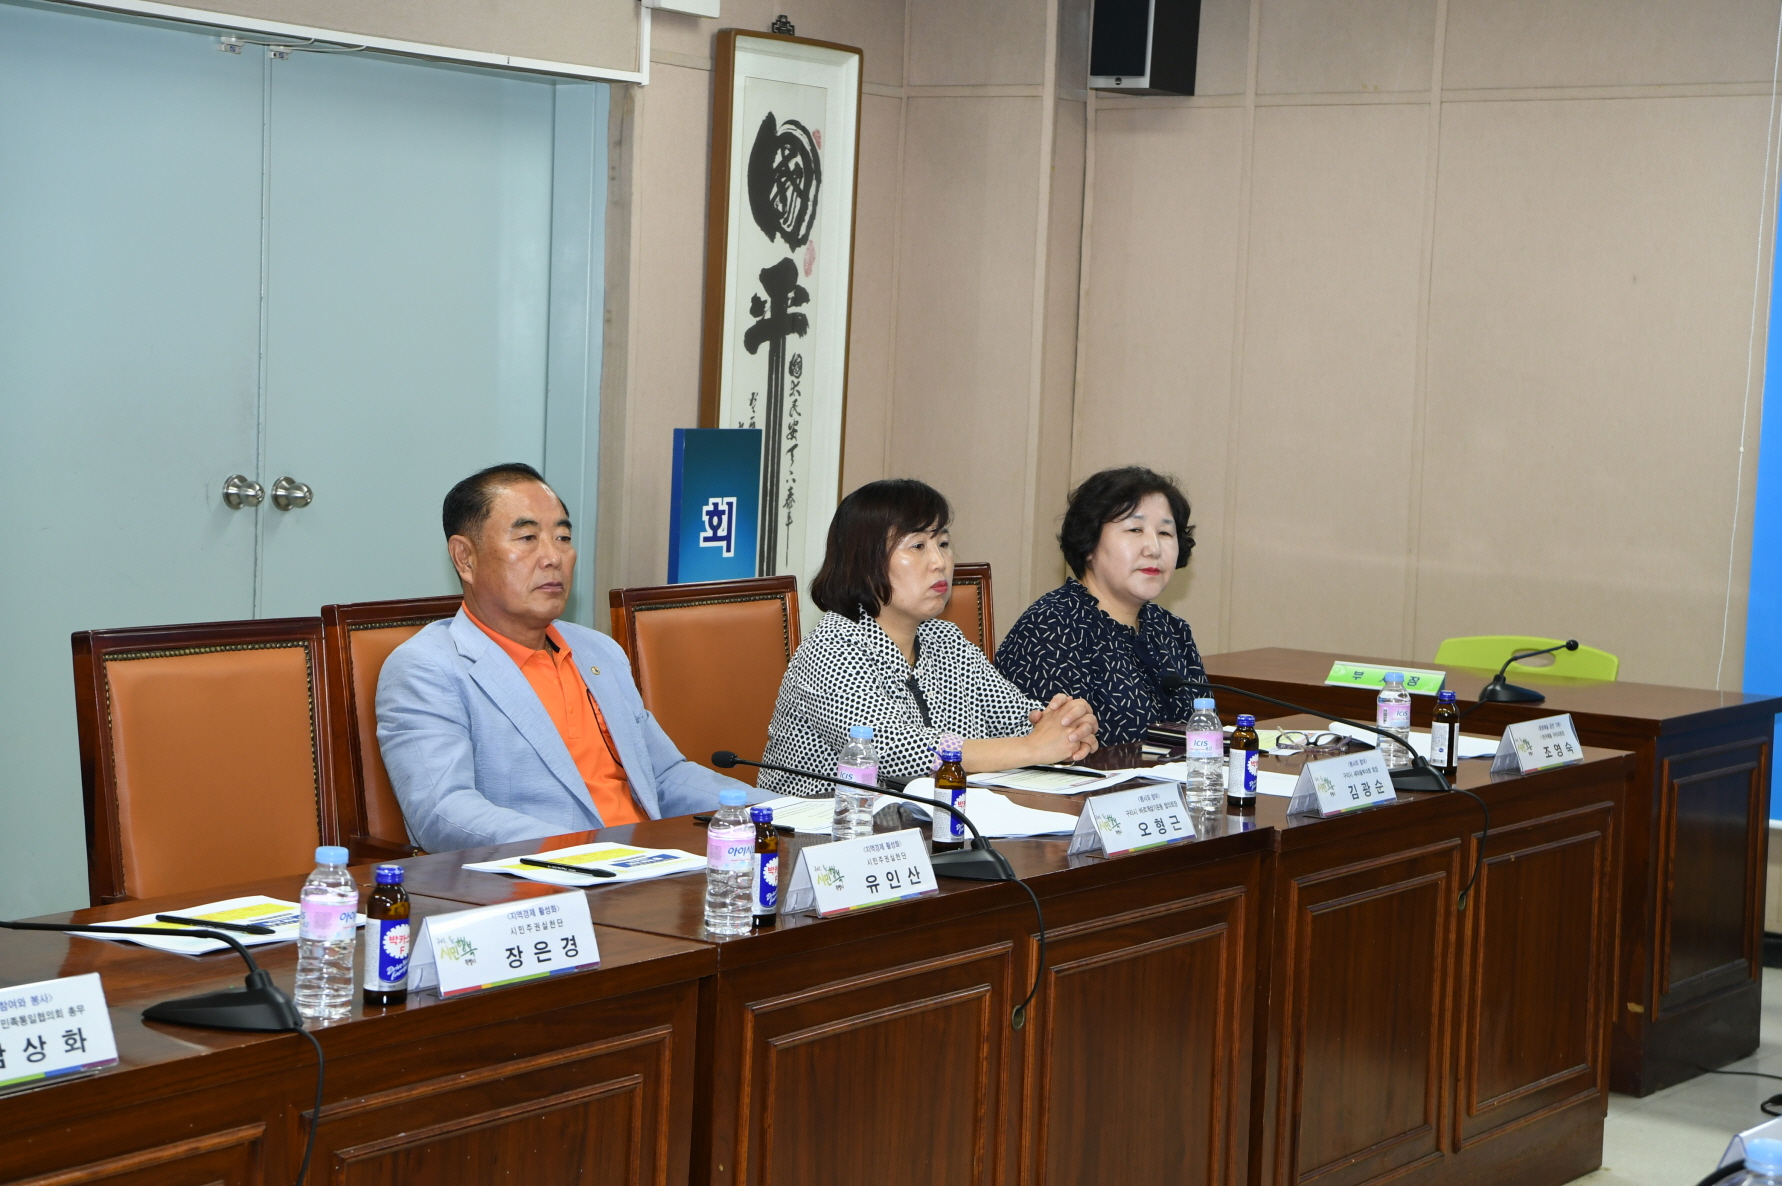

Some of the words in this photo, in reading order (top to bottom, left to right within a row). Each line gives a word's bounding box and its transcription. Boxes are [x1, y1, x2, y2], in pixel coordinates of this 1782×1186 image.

[700, 497, 737, 557] 회
[1347, 779, 1385, 801] 김광순
[1138, 814, 1182, 837] 오형근
[865, 865, 922, 894] 유인산
[510, 918, 564, 936] 시민주권실천단
[400, 946, 405, 954] F
[505, 934, 579, 969] 장은경
[68, 1004, 85, 1017] 총무
